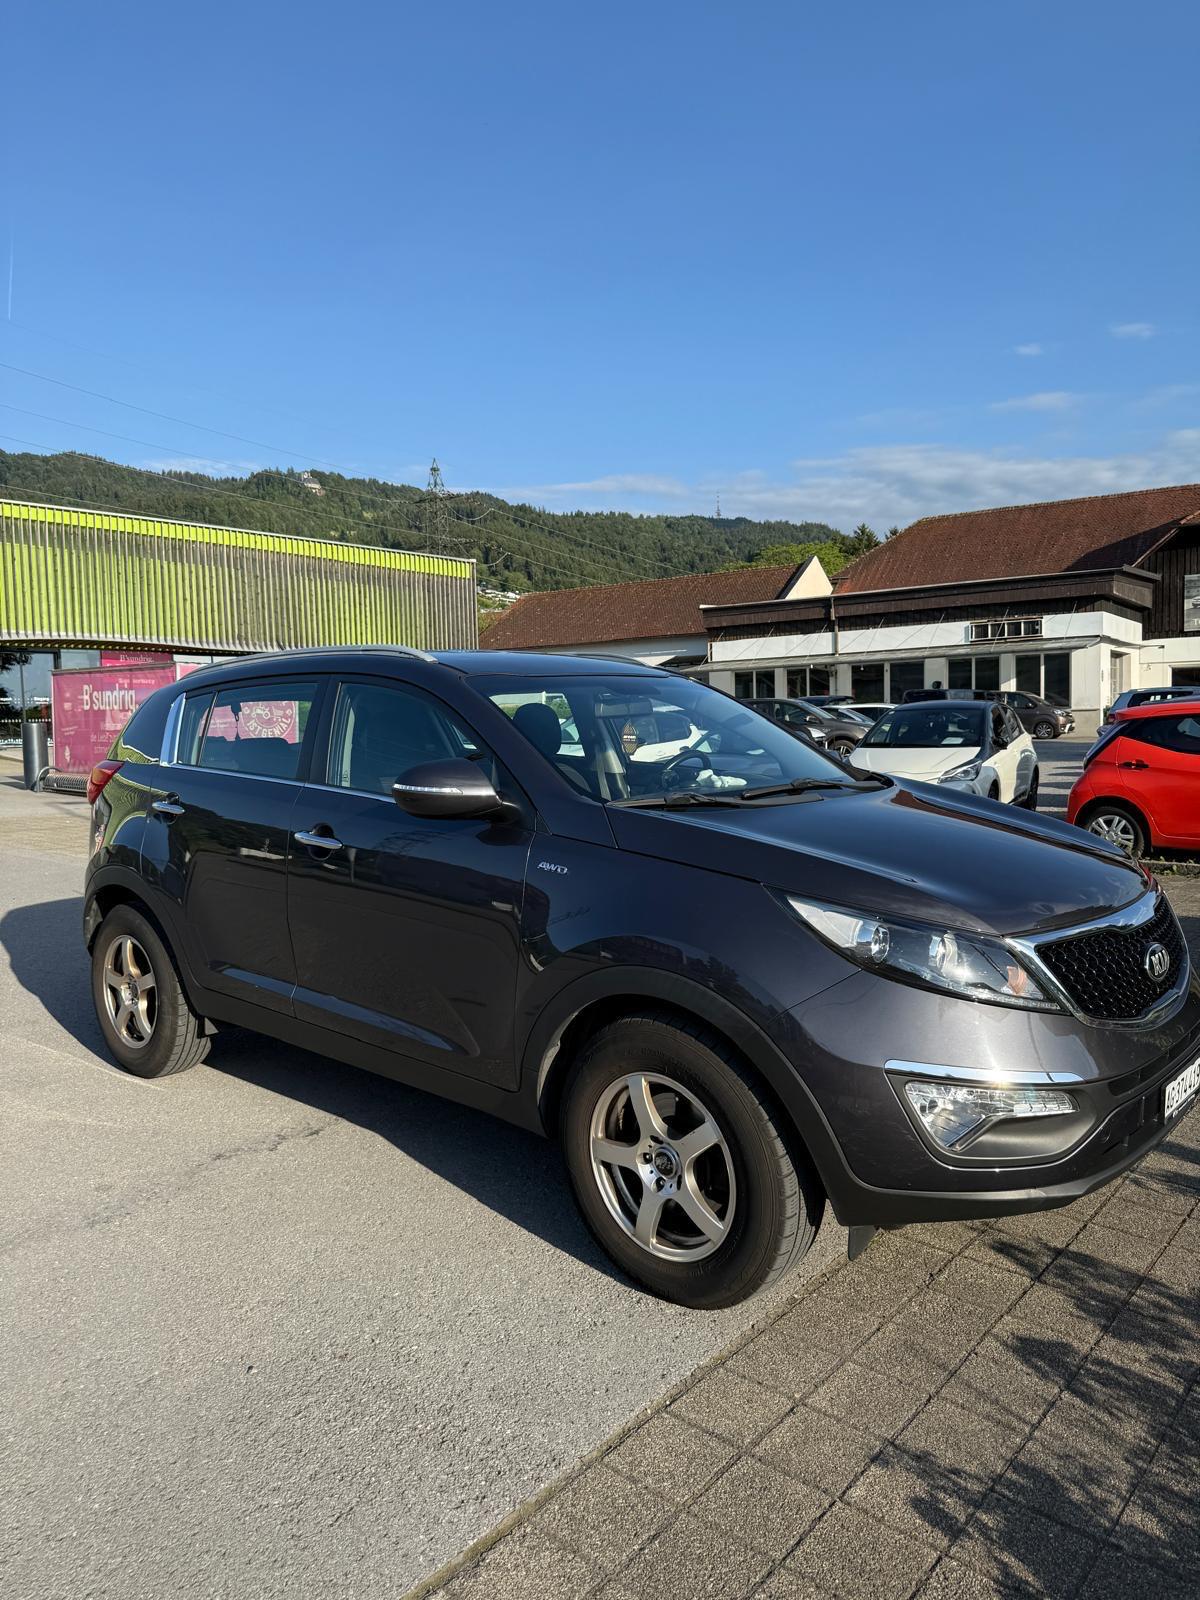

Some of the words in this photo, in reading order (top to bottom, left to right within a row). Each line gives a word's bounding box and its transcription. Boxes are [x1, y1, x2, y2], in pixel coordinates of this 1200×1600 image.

[247, 719, 263, 735] IST
[261, 717, 291, 738] GENIAL
[537, 861, 568, 875] AWD
